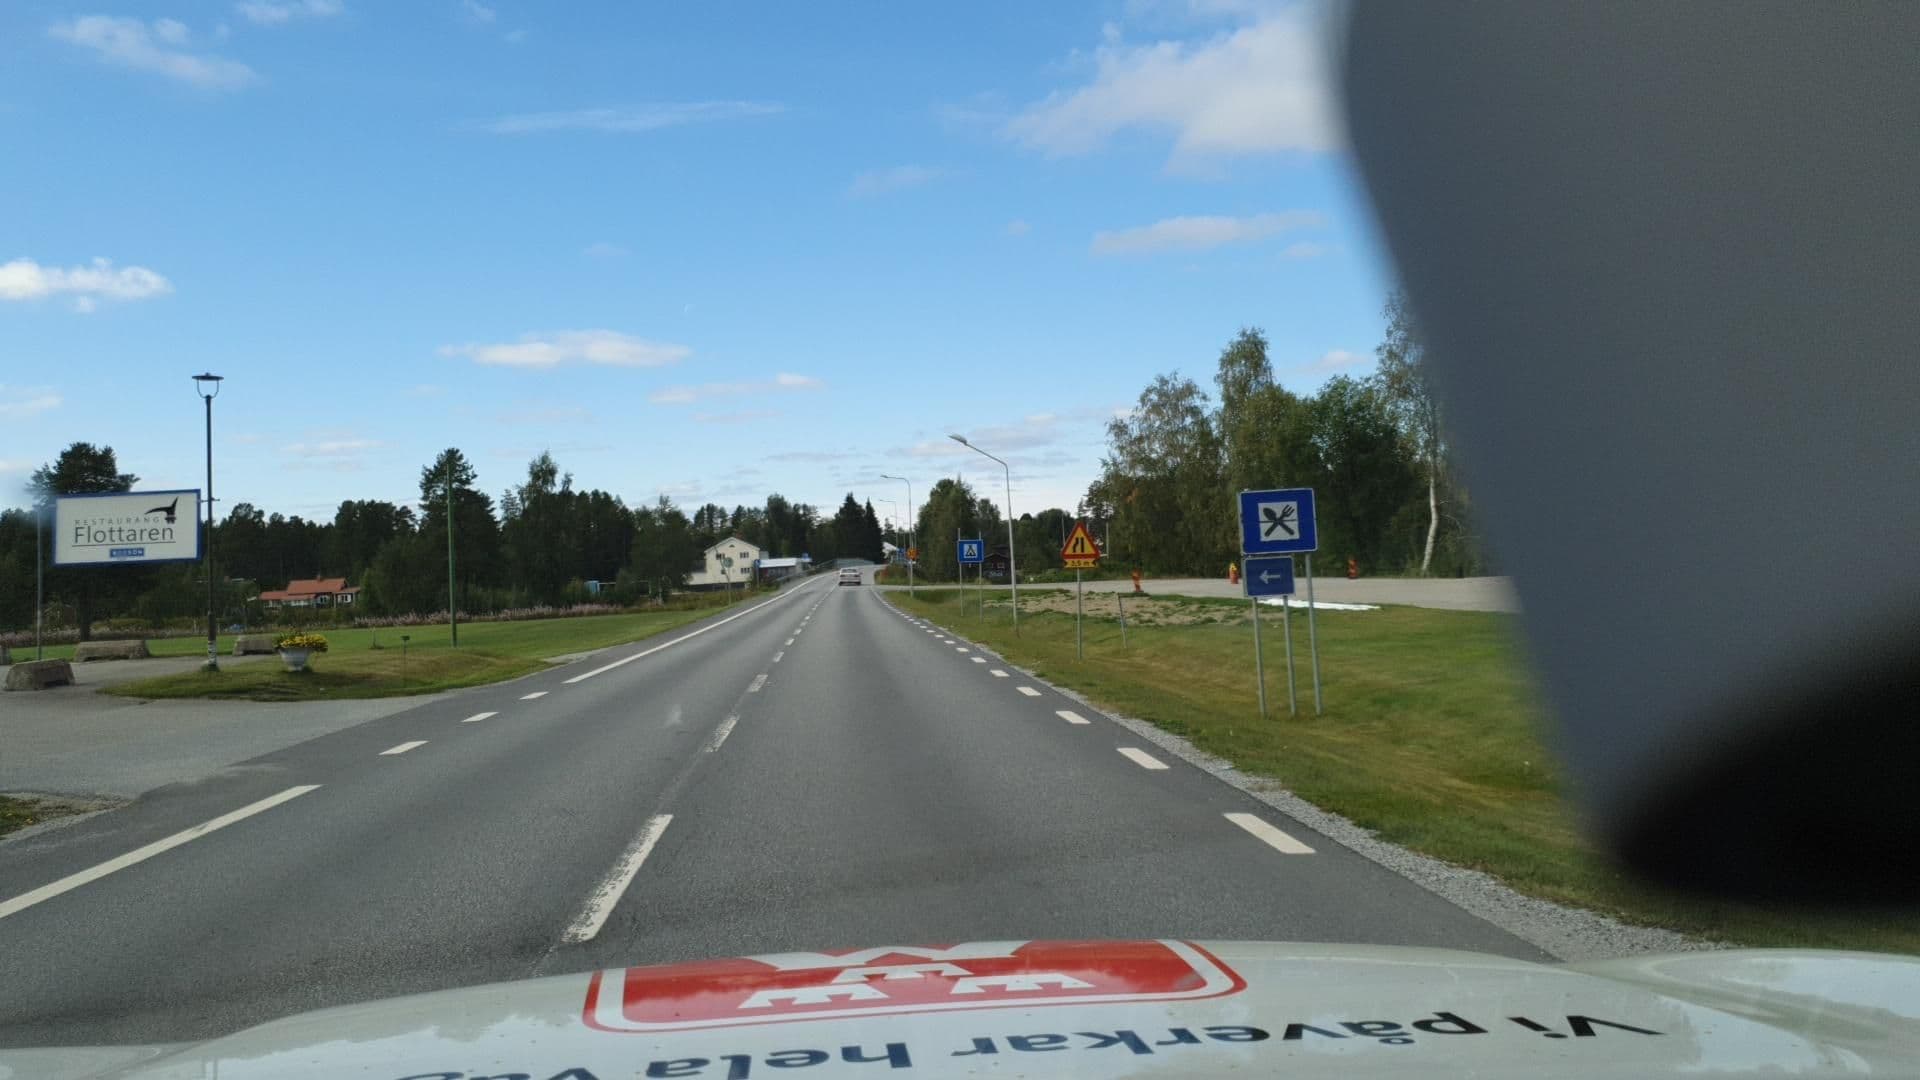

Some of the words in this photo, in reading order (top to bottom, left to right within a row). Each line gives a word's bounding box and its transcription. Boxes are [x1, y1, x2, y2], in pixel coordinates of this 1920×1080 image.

[74, 516, 160, 526] RESTAURANG
[74, 526, 174, 544] Flottaren
[950, 1012, 1488, 1057] påverkar
[1507, 1015, 1667, 1039] Vi
[646, 1042, 912, 1080] hela
